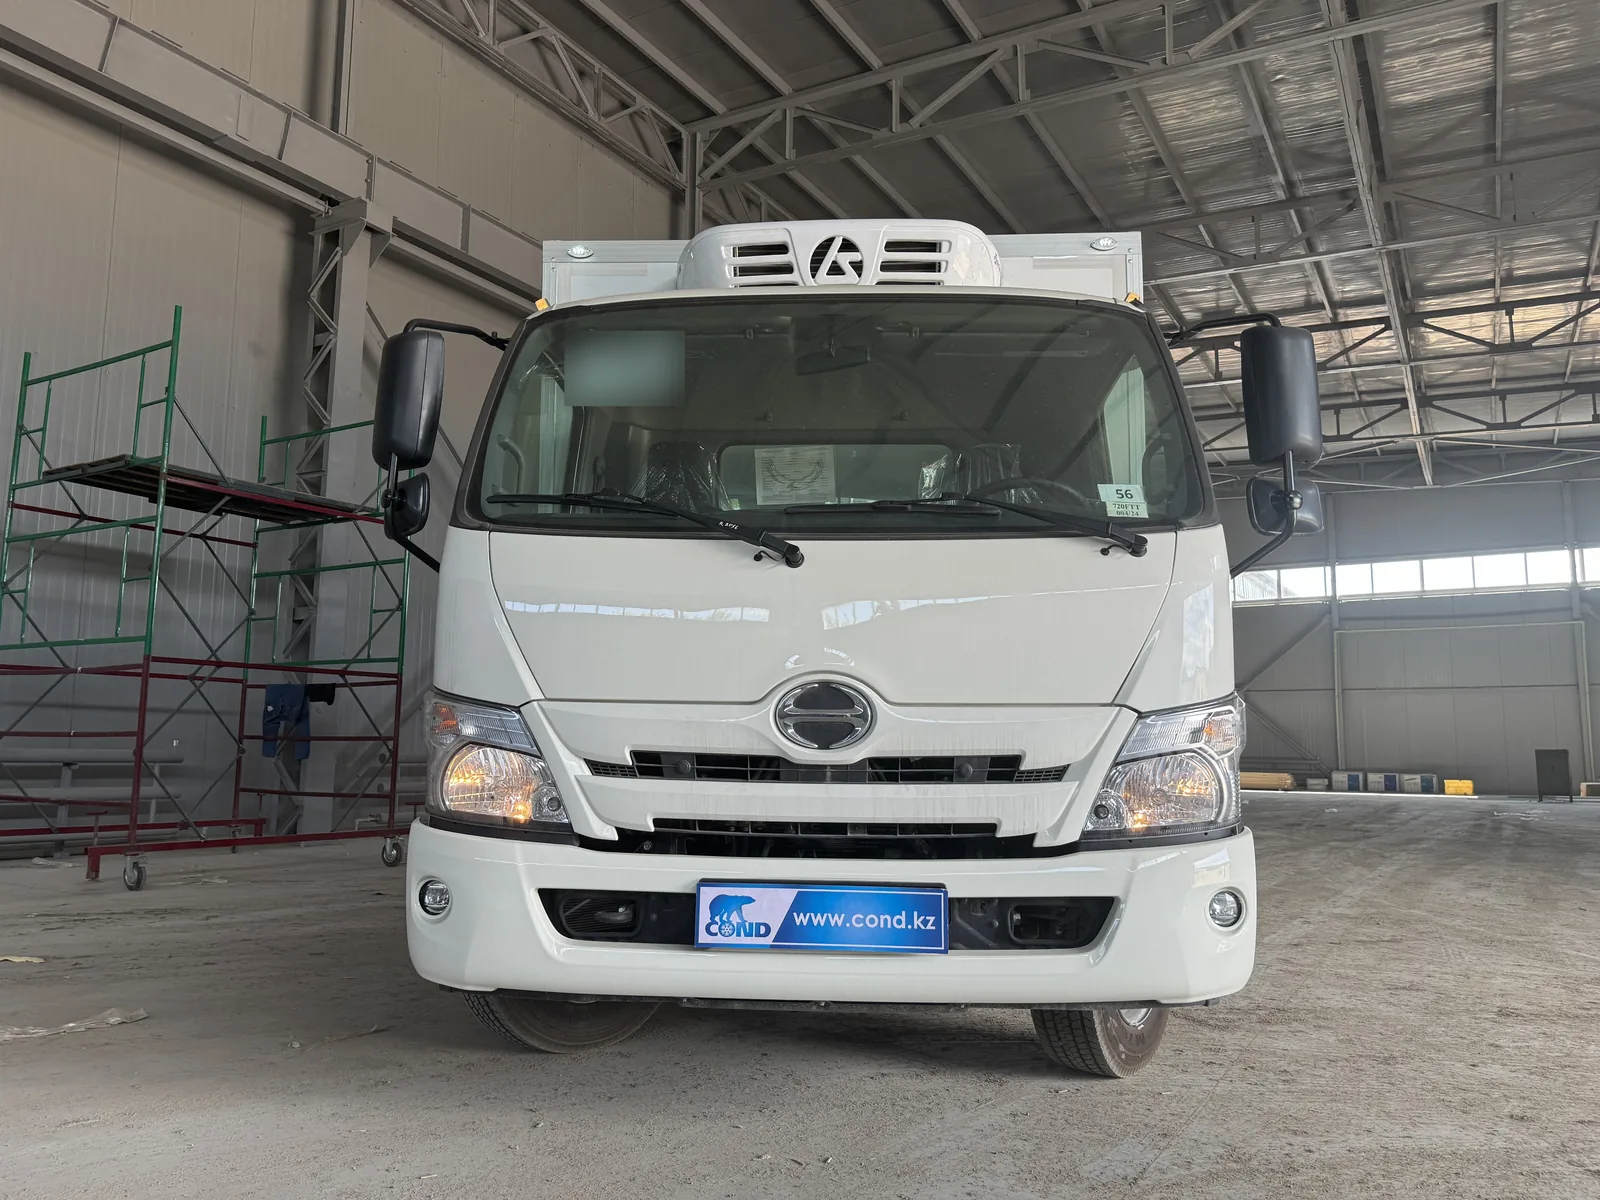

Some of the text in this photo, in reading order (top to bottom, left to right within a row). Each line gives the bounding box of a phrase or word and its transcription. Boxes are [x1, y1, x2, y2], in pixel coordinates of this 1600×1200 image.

[1115, 488, 1134, 500] 56
[793, 910, 936, 930] www.cond.kz
[704, 921, 772, 938] COND
